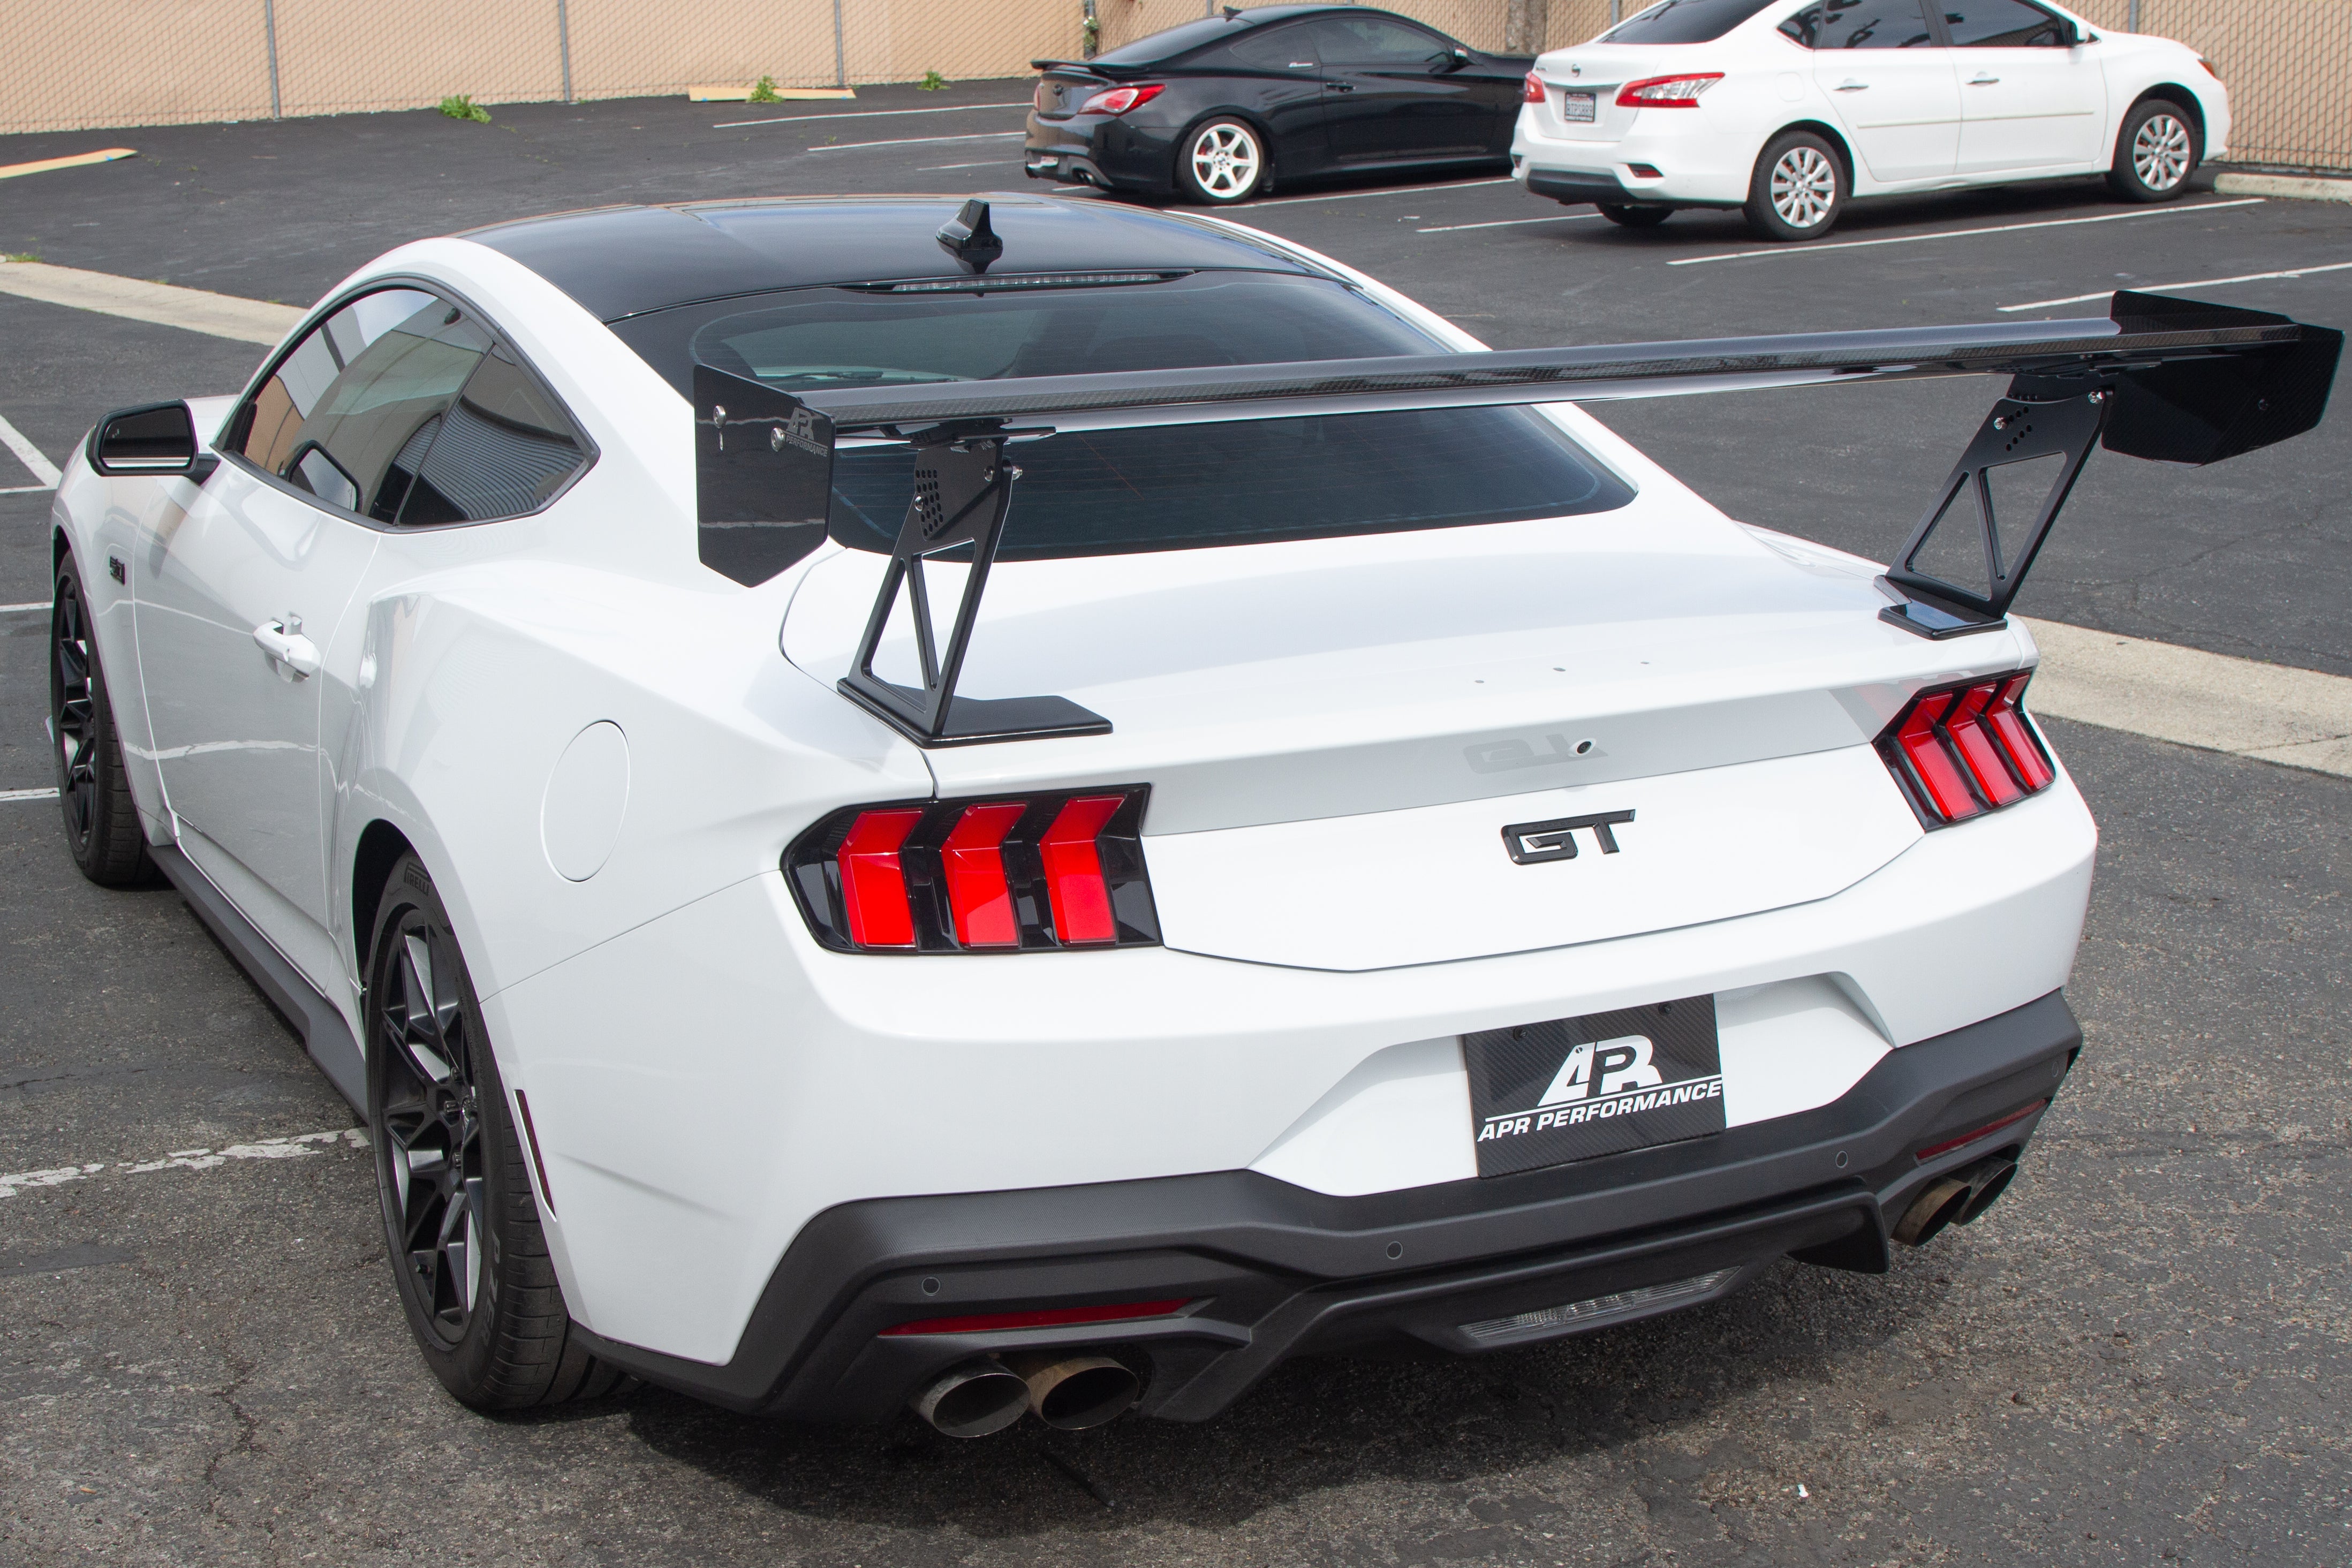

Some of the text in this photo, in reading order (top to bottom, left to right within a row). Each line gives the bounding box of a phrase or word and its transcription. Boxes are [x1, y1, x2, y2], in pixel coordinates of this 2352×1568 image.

[785, 435, 828, 457] PERFORMANCE
[1501, 809, 1636, 866] GT
[403, 861, 432, 897] PIRELLI
[1477, 1080, 1722, 1142] APR PERFORMANCE
